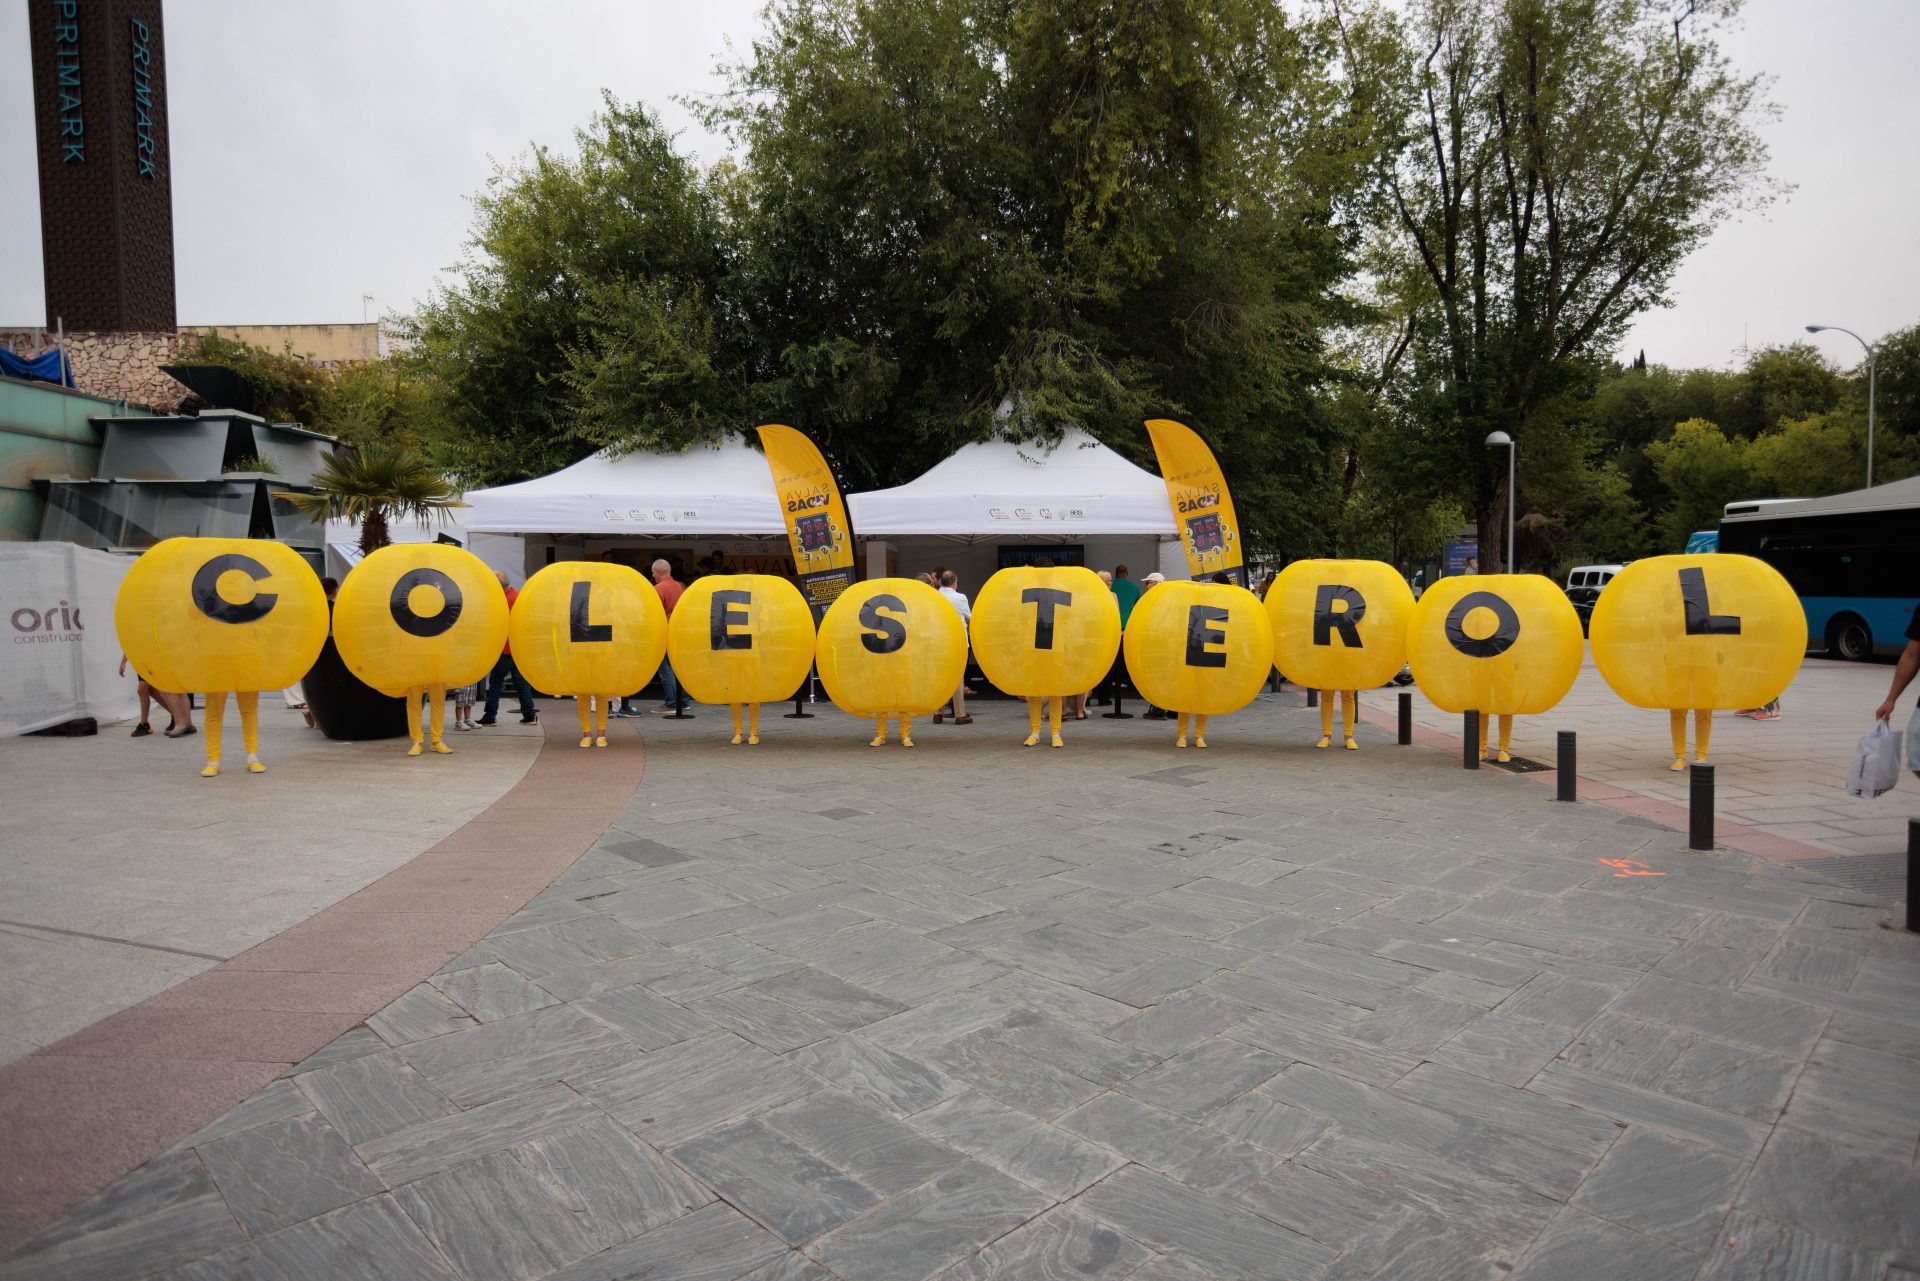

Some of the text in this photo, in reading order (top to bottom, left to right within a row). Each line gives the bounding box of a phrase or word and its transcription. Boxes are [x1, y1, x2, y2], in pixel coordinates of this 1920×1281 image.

[54, 0, 85, 163] PRIMARK
[131, 18, 156, 181] PRIMARK
[192, 554, 1740, 667] C O L E S T E R O L
